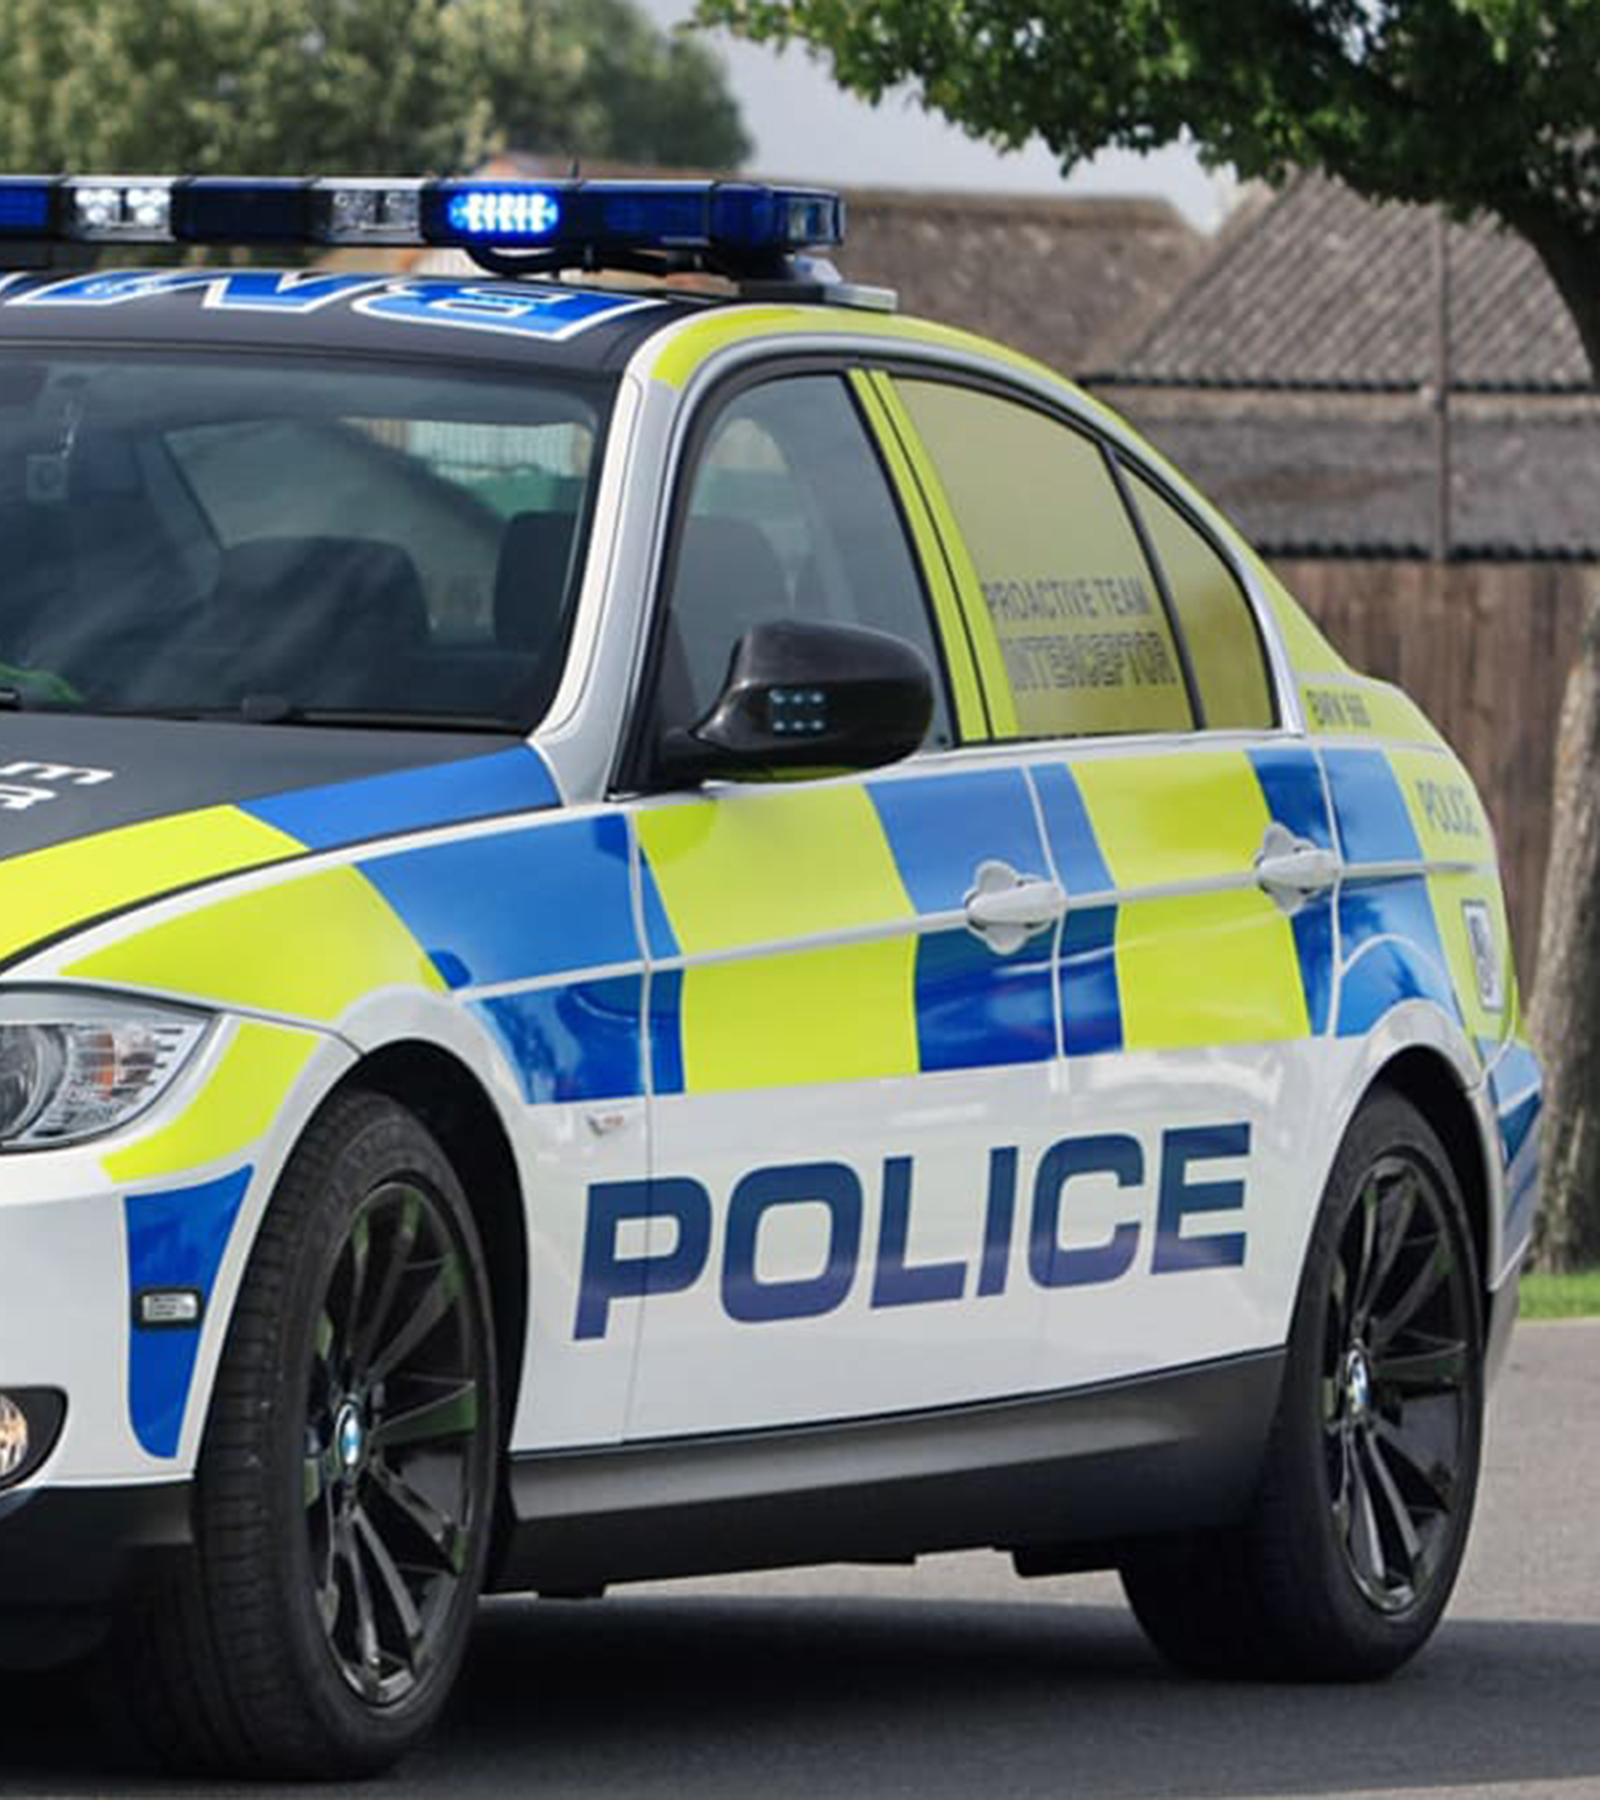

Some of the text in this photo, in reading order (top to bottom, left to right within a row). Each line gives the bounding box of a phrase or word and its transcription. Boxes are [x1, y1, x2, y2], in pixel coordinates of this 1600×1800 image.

[980, 574, 1152, 620] PROACTIVE TEAM
[1000, 631, 1179, 690] INTERCEPTOR
[572, 1121, 1252, 1342] POLICE
